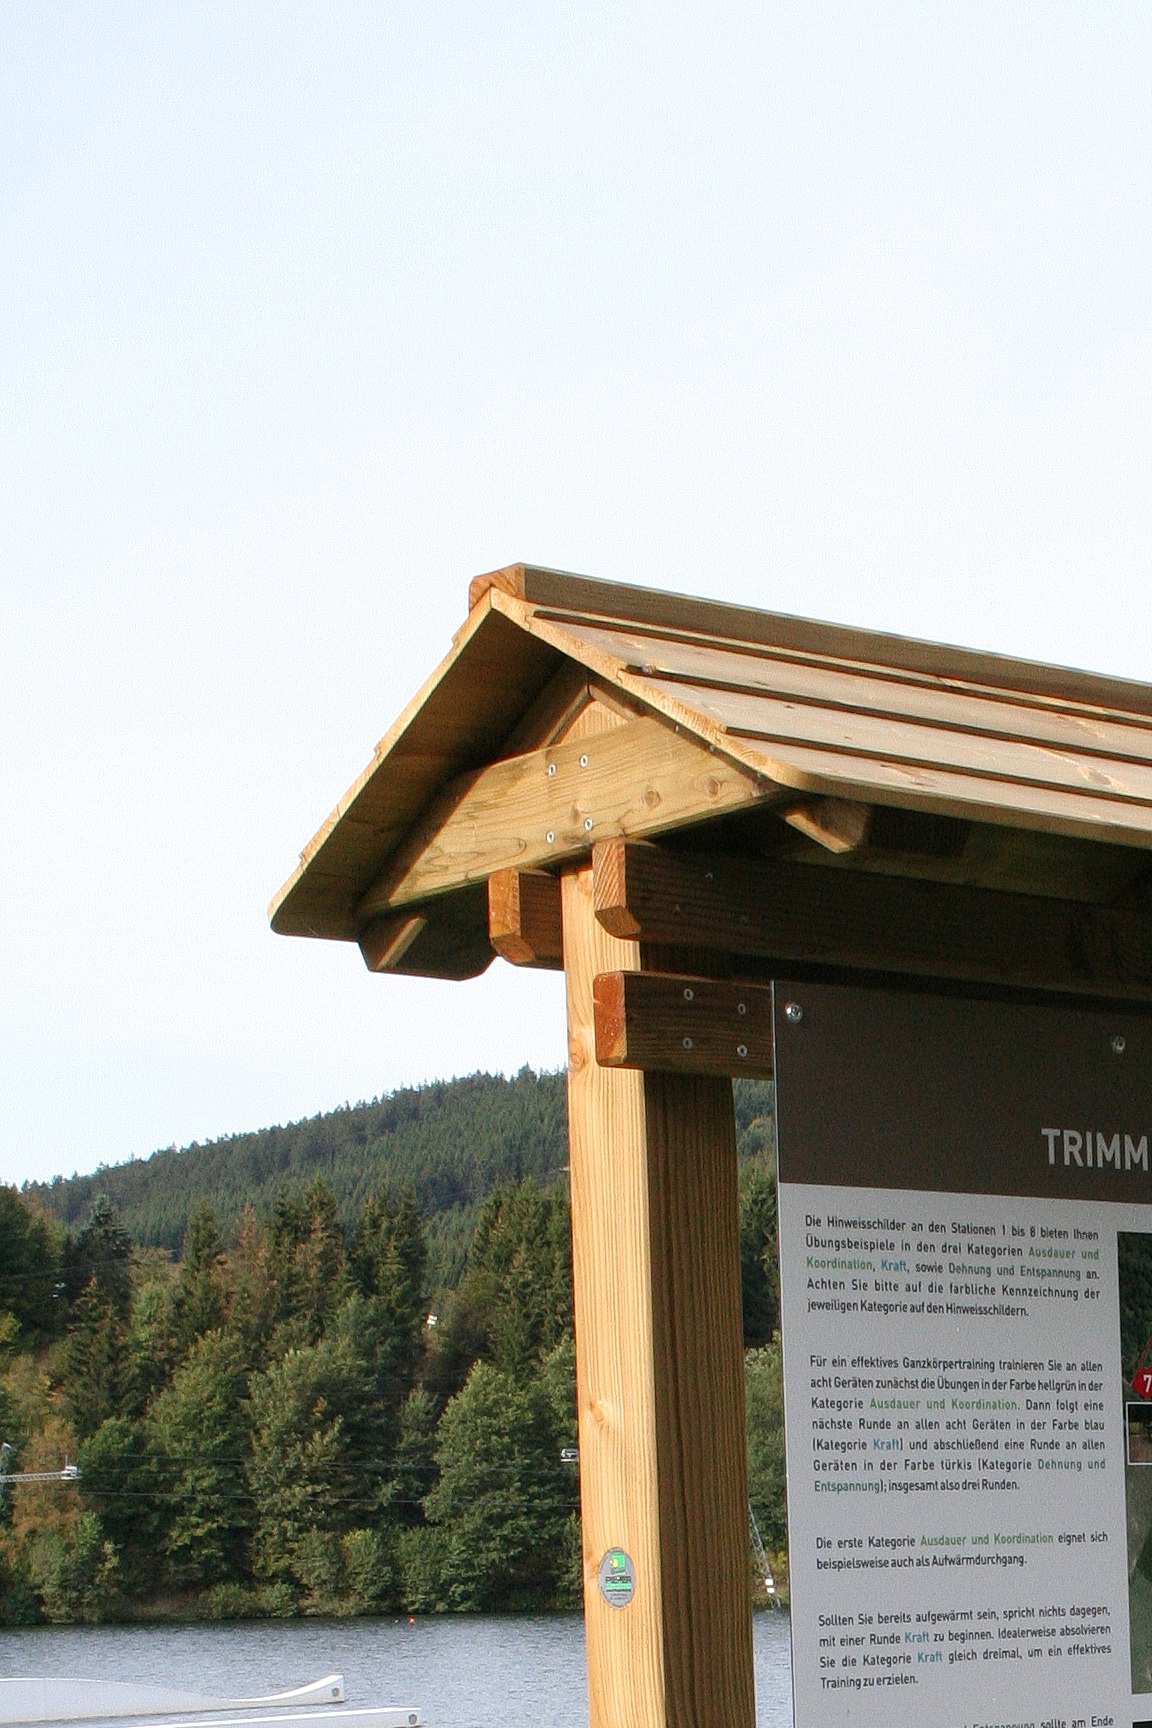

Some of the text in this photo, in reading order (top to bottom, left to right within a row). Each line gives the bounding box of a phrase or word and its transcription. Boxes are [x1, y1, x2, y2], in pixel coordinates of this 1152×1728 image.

[805, 1214, 1099, 1241] Die Hinweisschilder an den Stationen 1 bis 8 bieten Ihnen
[805, 1232, 1101, 1260] Übungsbeispiele in den drei Kategorien Ausdauer und
[806, 1256, 1100, 1281] Koordination, Kraft, sowie Dehnung und Entspannung an.
[806, 1277, 1100, 1301] Achten Sie bitte auf die farbliche Kennzeichnung der
[807, 1298, 1029, 1316] jeweiligen Kategorie auf den Hinweisschildern.
[815, 1530, 1108, 1550] Die erste Kategorie Ausdauer und Koordination eignet sich
[816, 1552, 1027, 1572] beispielsweise auch als Aufwärmdurchgang.
